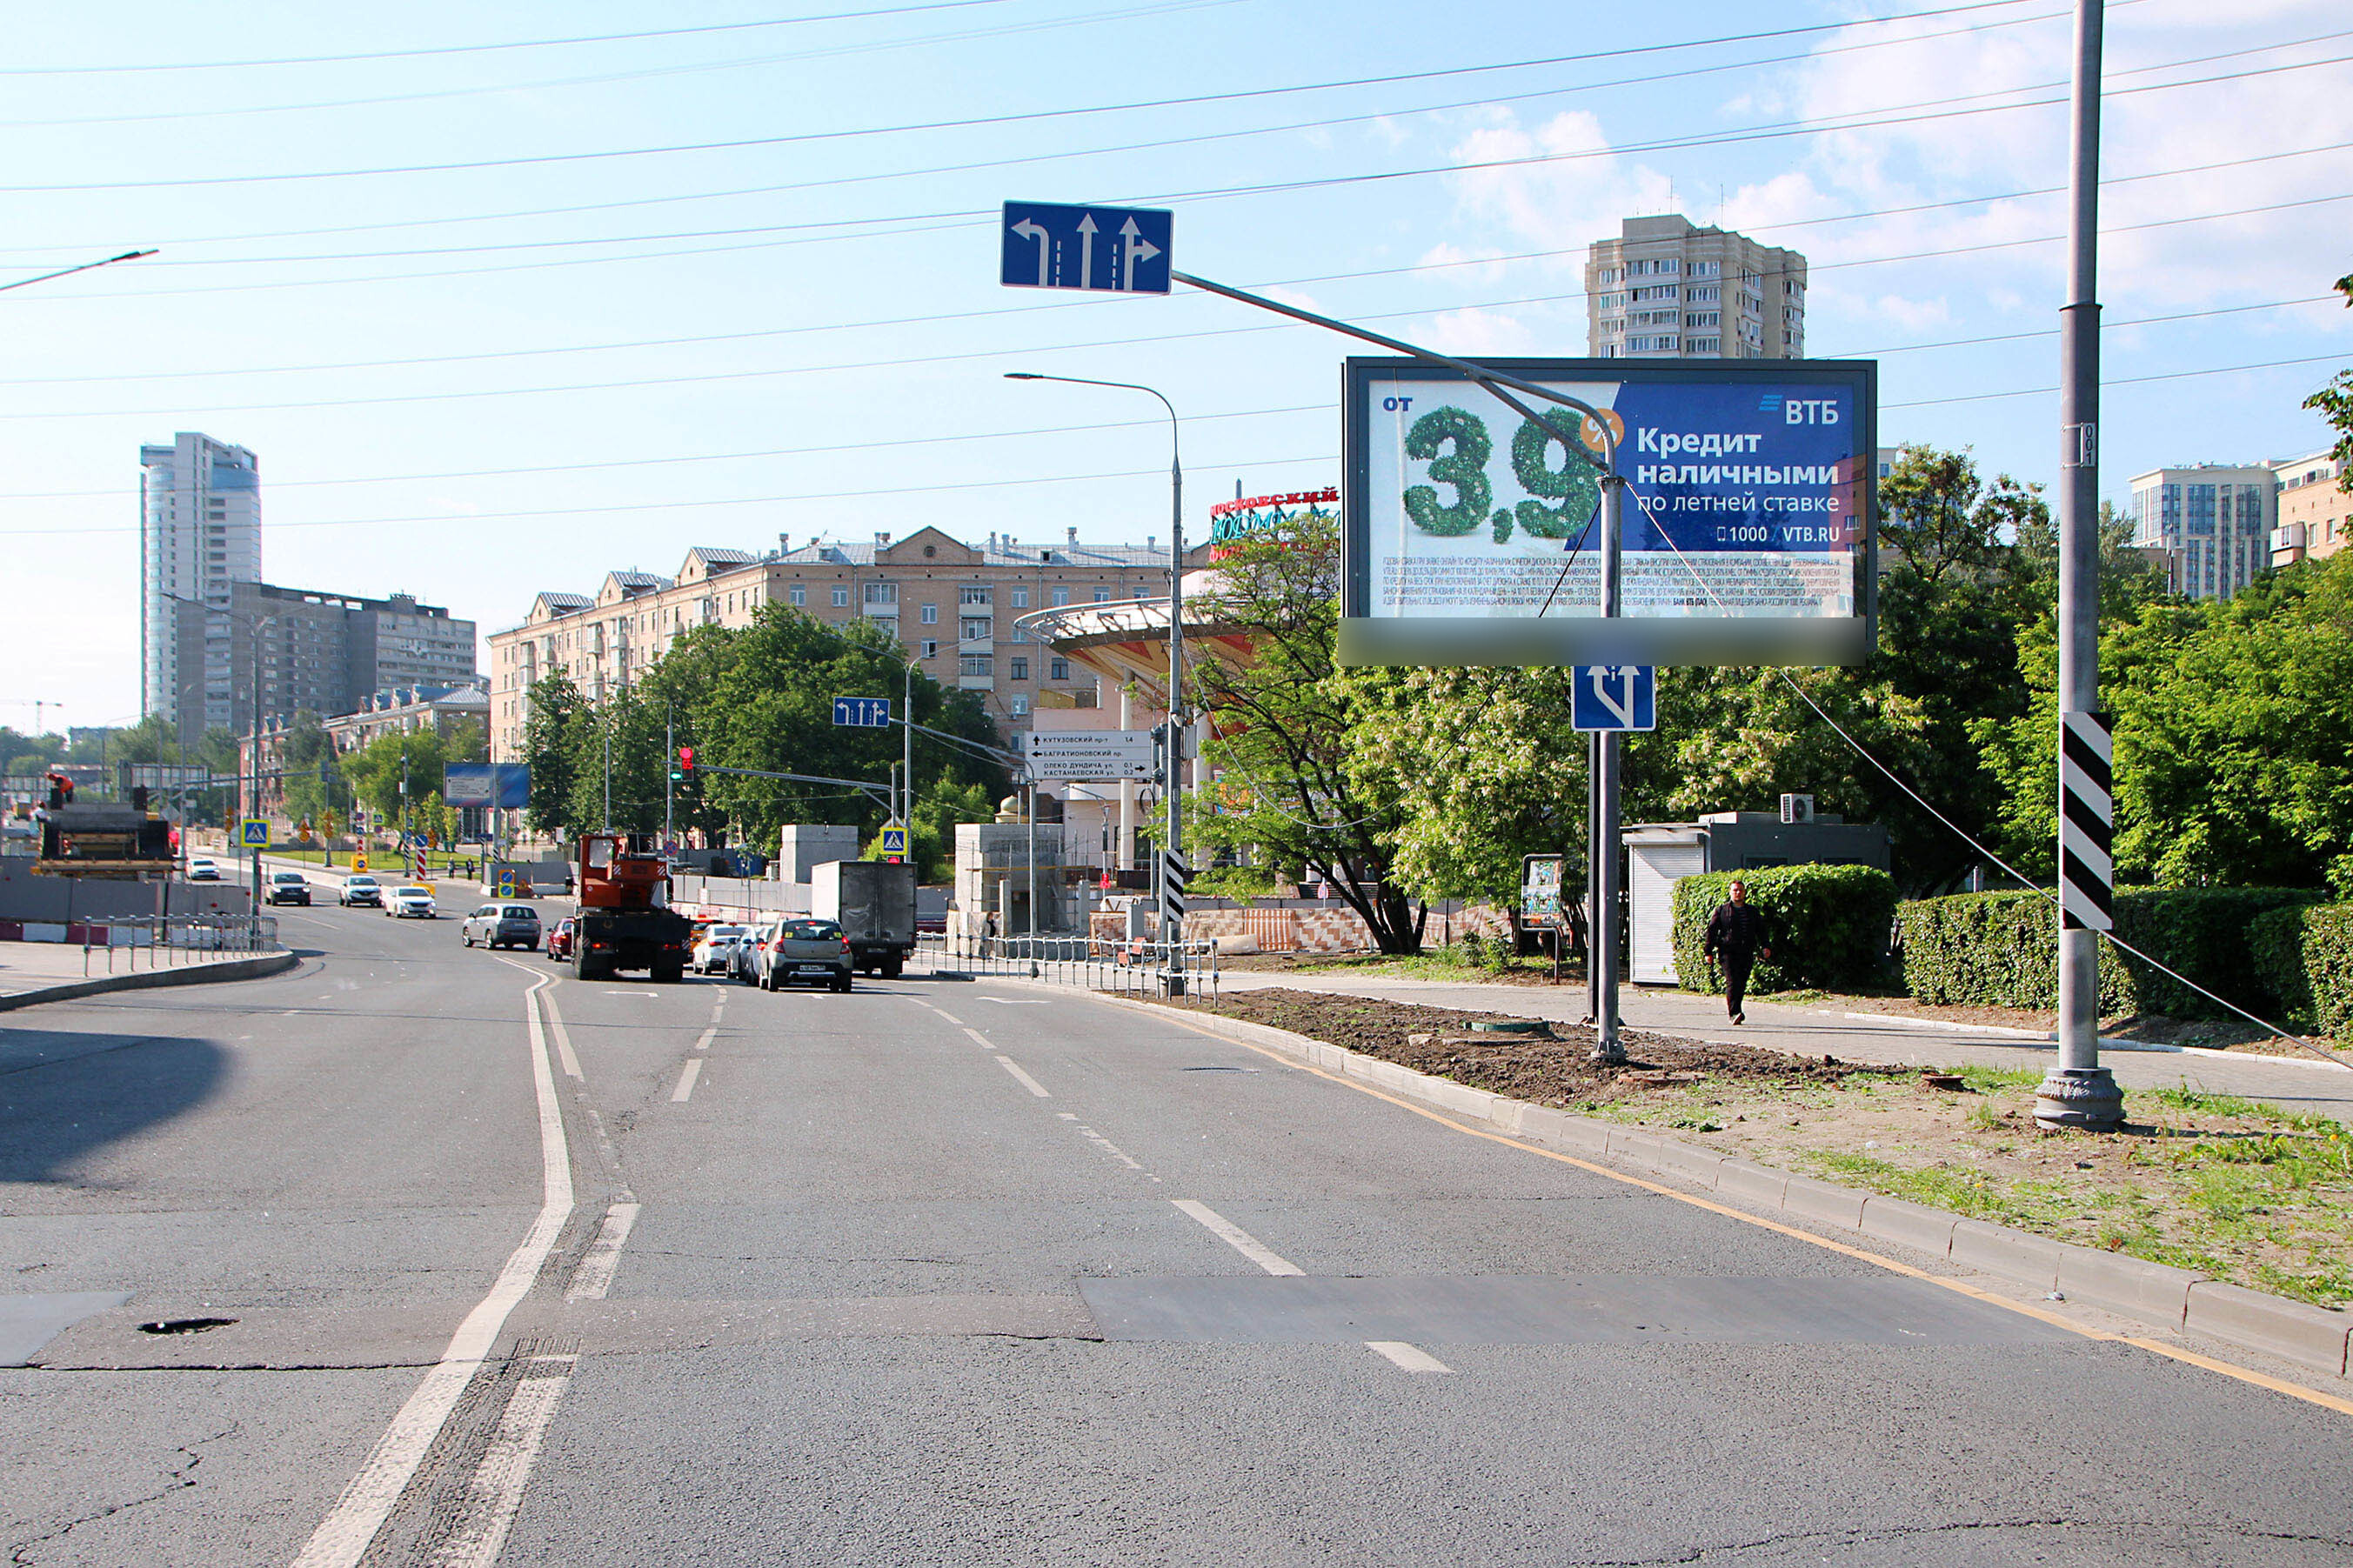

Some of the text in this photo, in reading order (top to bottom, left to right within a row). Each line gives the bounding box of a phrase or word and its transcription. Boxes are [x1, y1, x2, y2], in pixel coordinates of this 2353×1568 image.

[1786, 400, 1839, 424] ВТБ
[1638, 427, 1761, 459] Кредит
[1638, 464, 1839, 484] наличными
[1638, 490, 1839, 511] по летней ставке
[1729, 526, 1768, 542] 1000
[1783, 526, 1839, 542] VTB.RU
